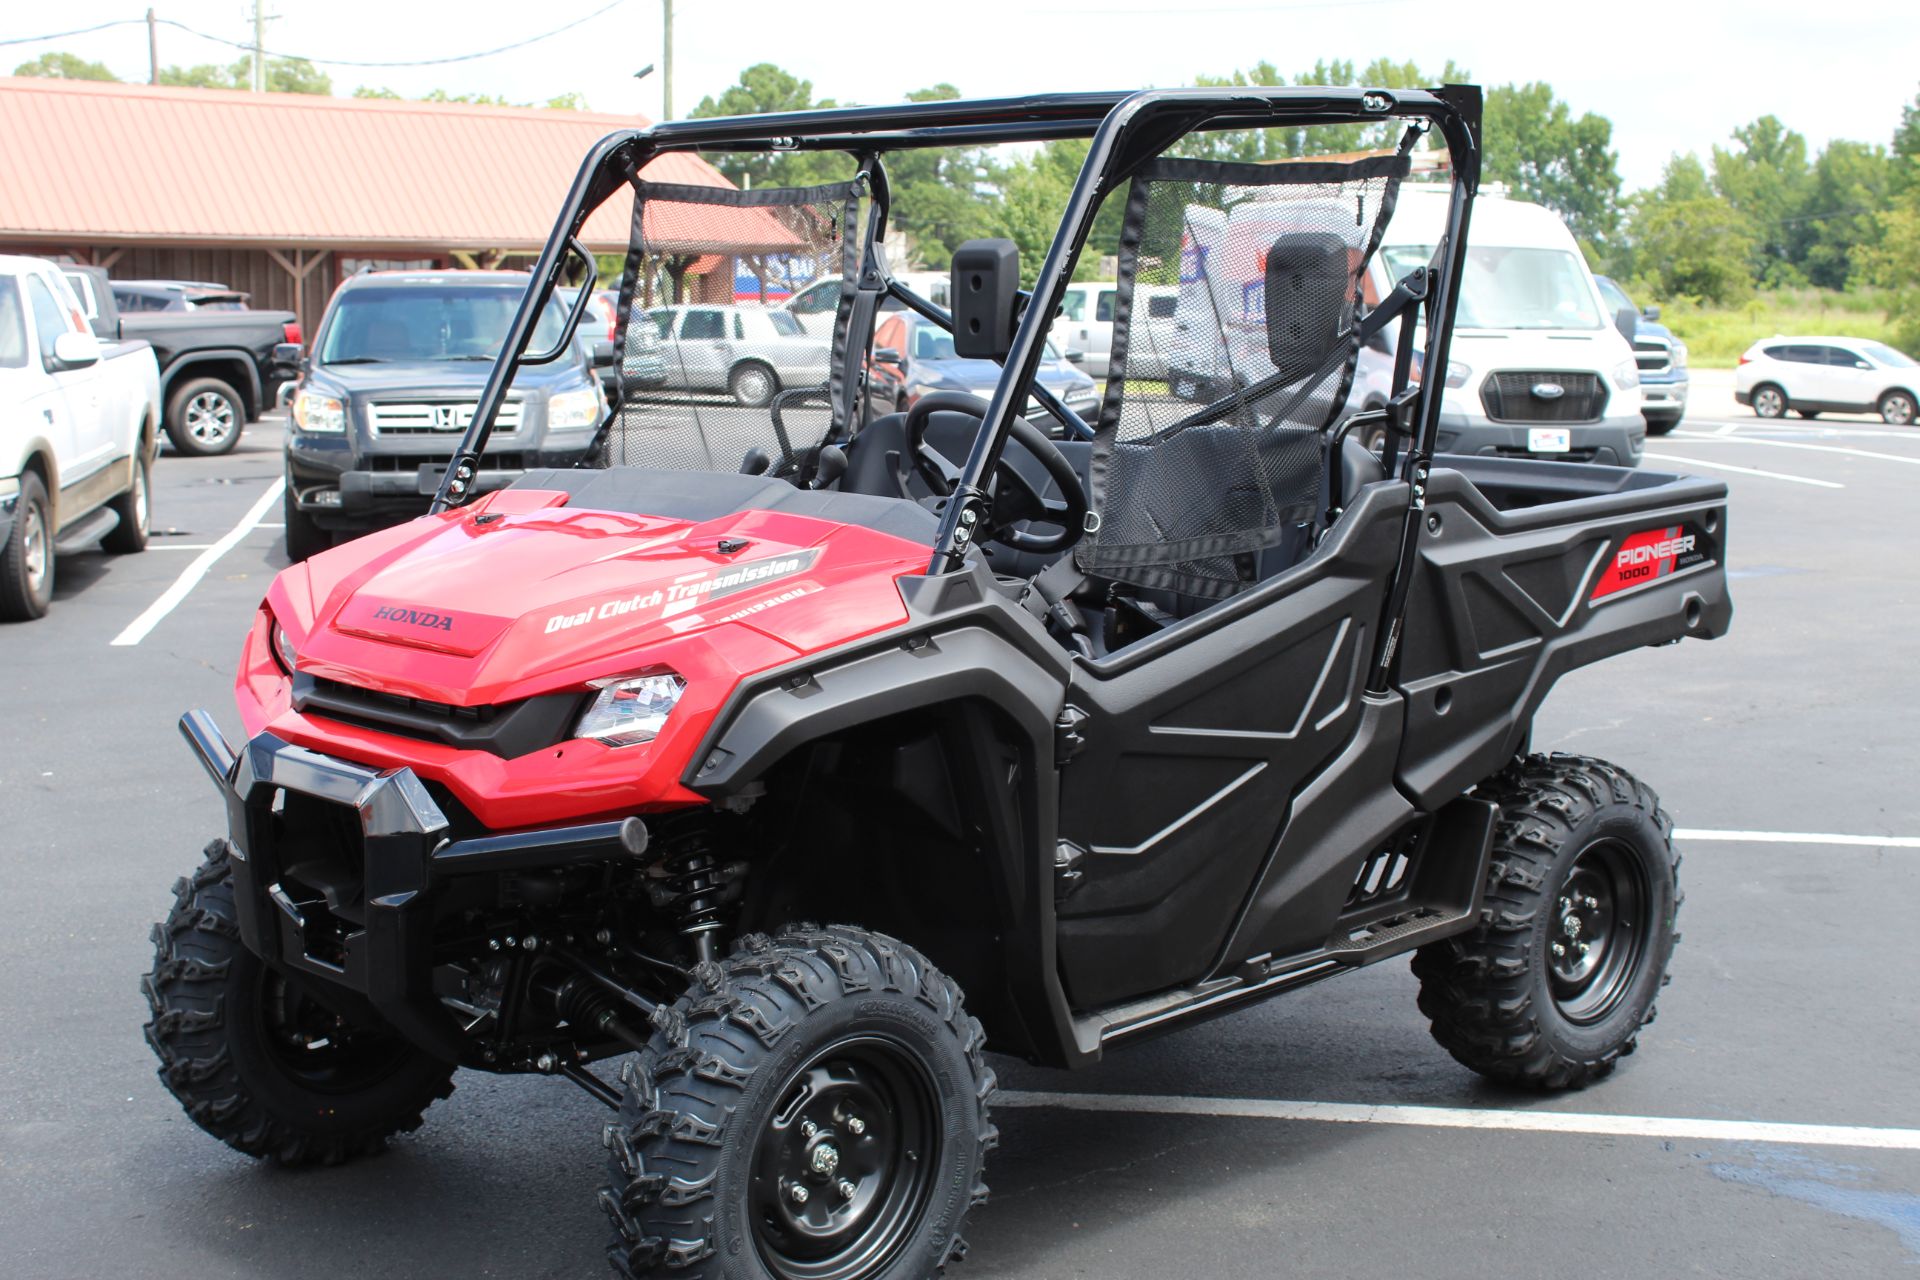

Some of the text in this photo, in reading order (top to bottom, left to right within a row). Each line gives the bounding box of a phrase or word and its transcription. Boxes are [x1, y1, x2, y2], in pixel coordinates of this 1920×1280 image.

[1617, 535, 1695, 568] PIONEER
[1679, 552, 1704, 566] HONDA
[1618, 566, 1650, 581] 1000
[544, 558, 800, 634] Dual Clutch Transmission
[372, 606, 454, 631] HONDA
